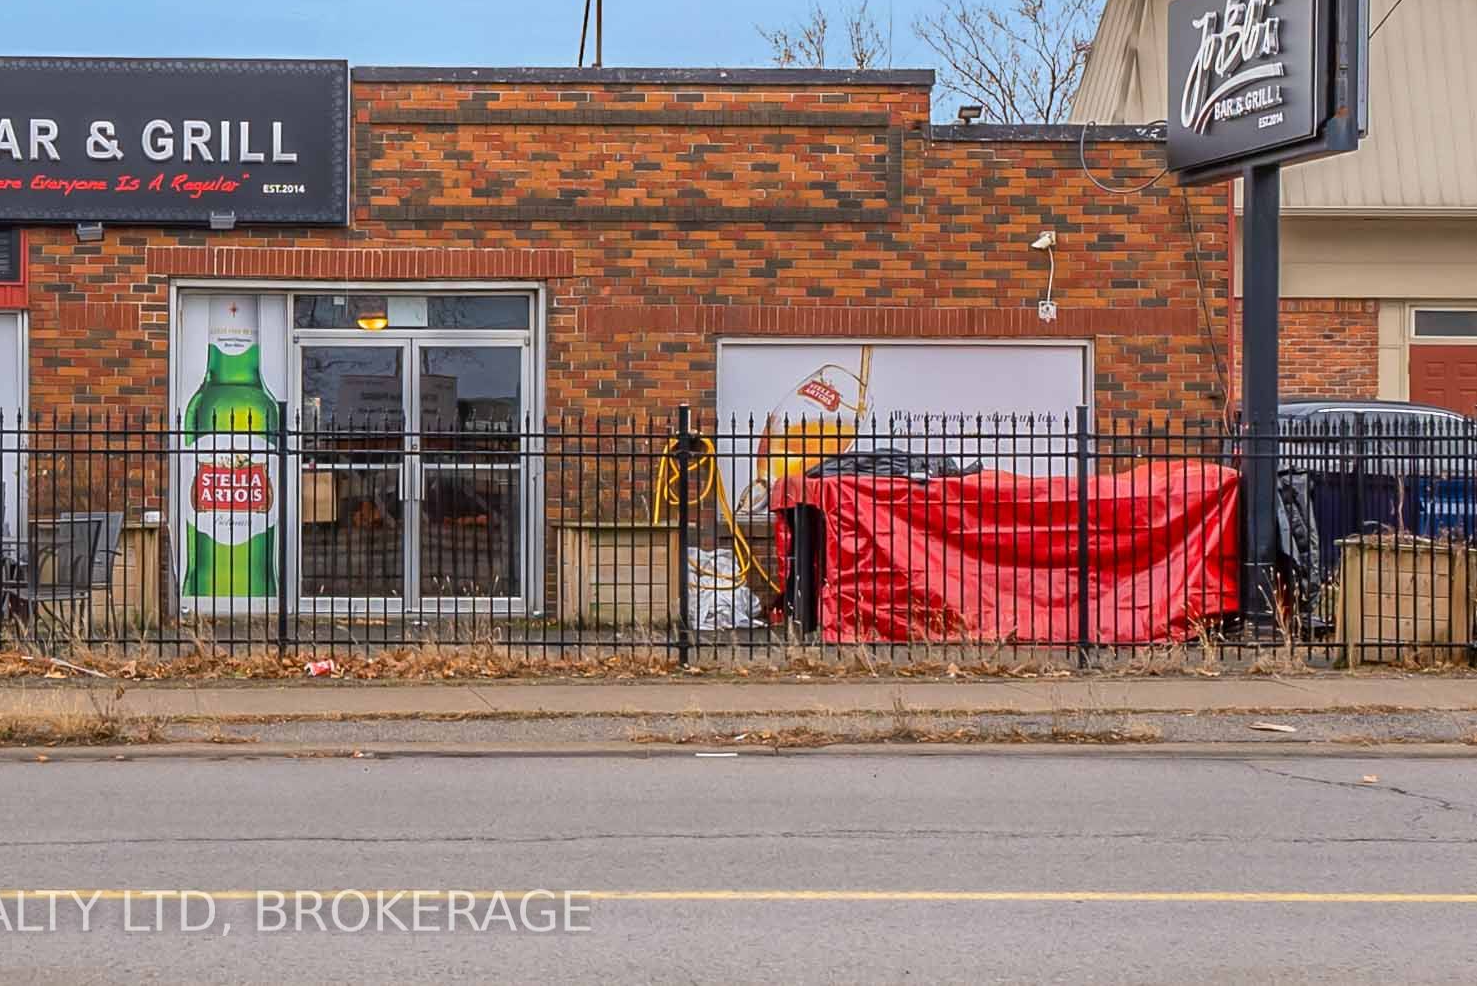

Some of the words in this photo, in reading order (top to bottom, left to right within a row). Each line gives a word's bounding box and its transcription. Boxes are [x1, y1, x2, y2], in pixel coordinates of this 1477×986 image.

[1214, 98, 1233, 121] BAR
[86, 119, 124, 161] &
[141, 119, 298, 163] GRILL
[115, 173, 140, 191] Is
[148, 174, 162, 191] A
[262, 183, 306, 195] EST.2014
[202, 473, 262, 487] STELLA
[201, 488, 262, 503] ARTOIS
